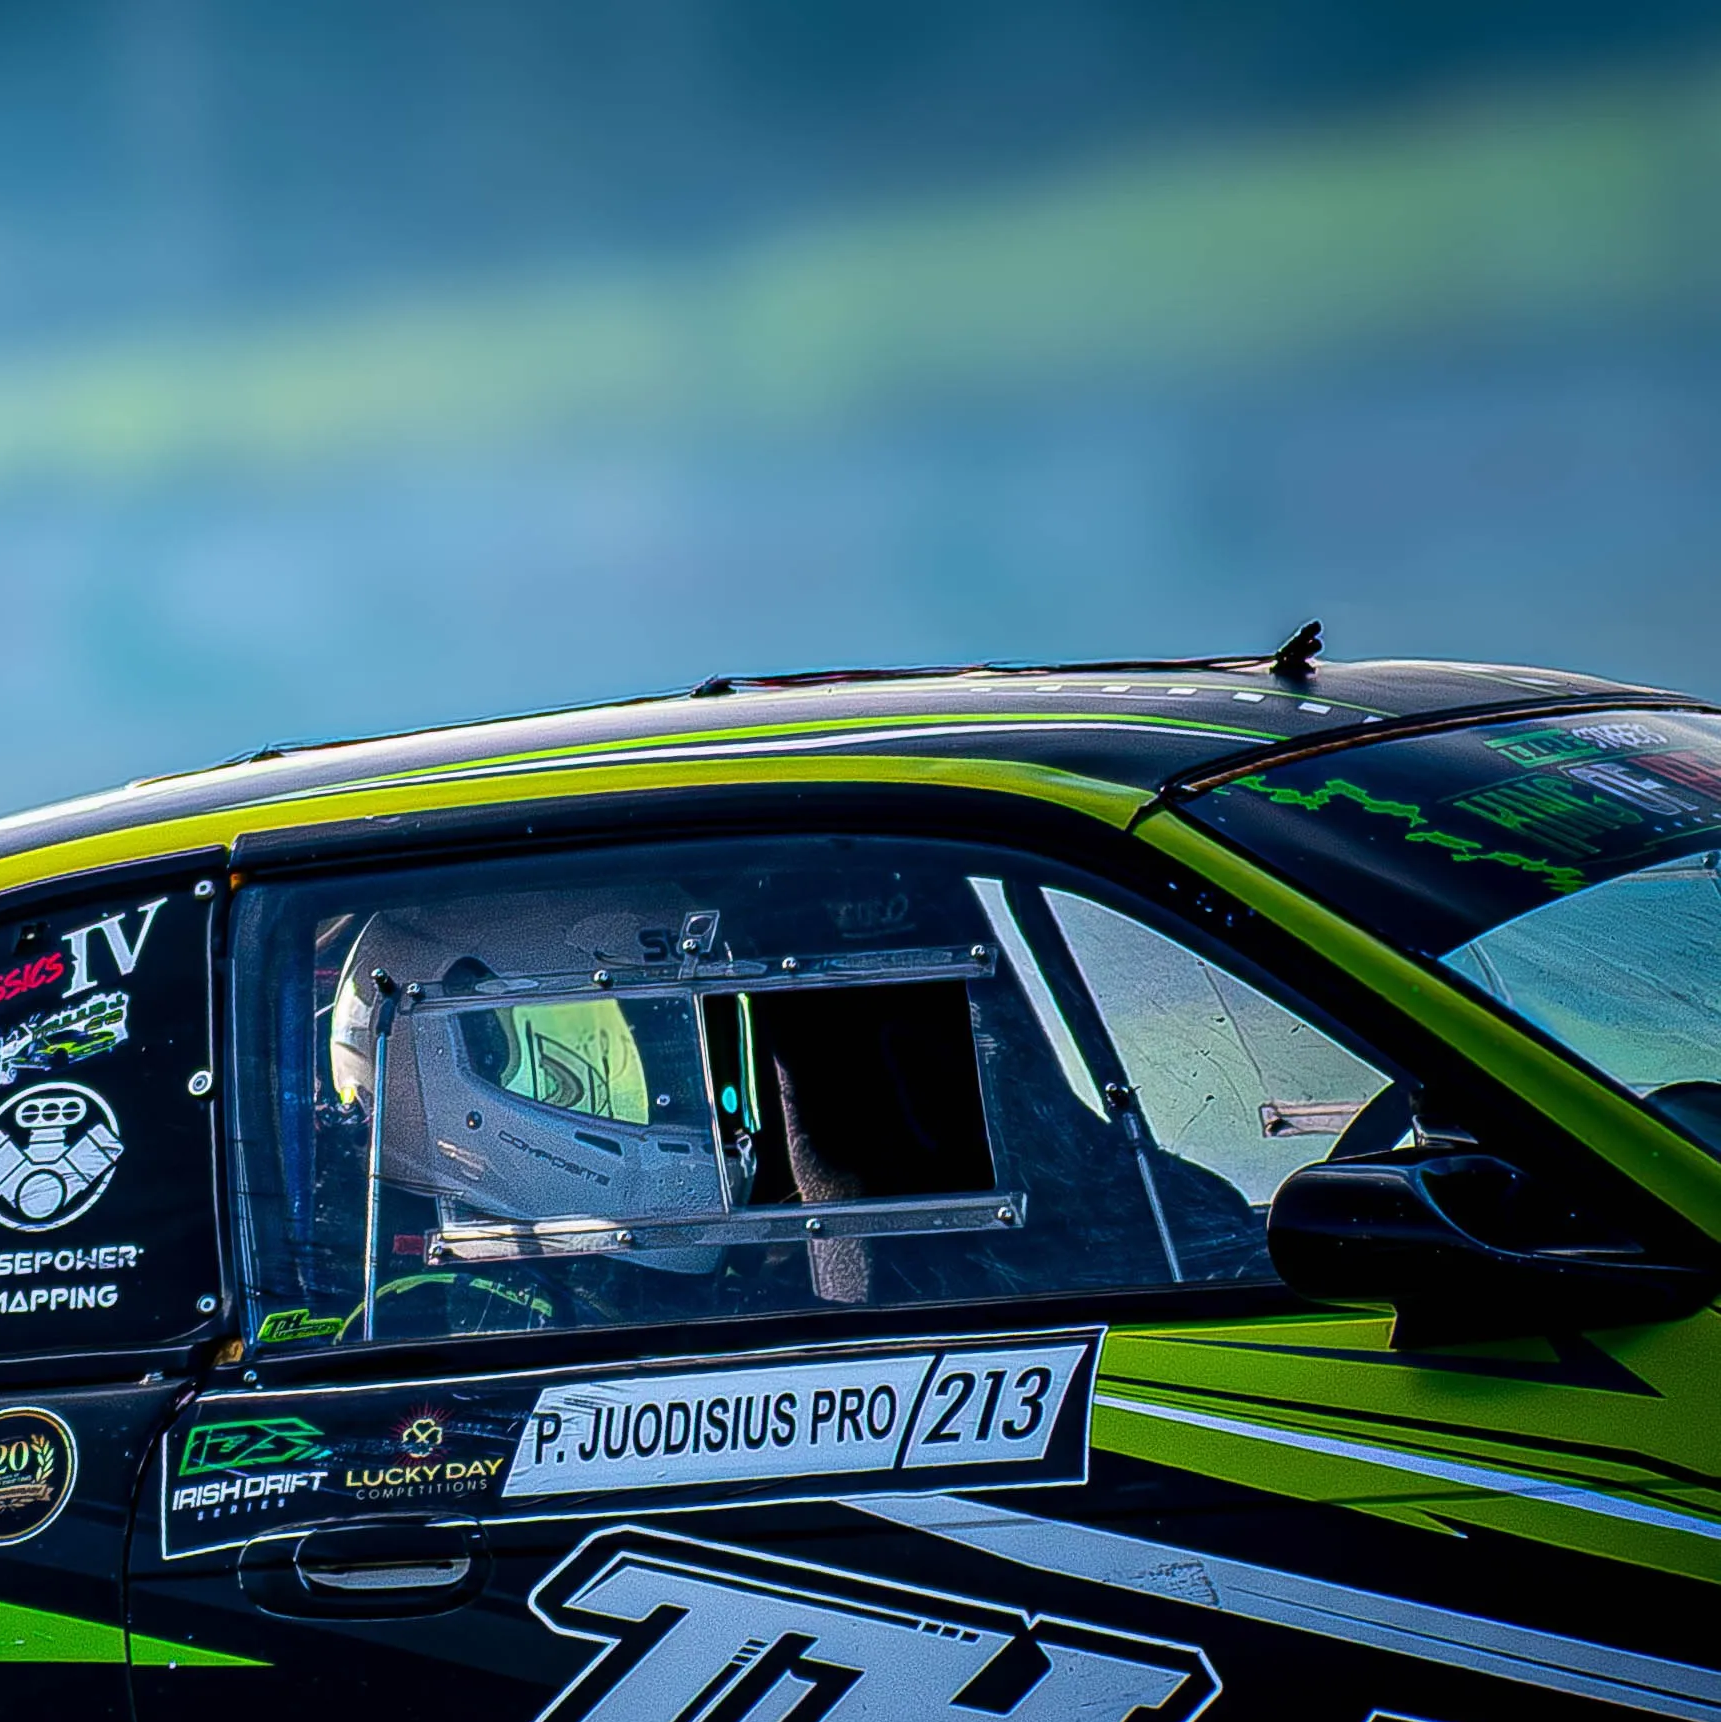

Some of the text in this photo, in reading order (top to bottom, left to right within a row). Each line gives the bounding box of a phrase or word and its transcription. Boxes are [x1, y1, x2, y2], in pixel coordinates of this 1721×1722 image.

[61, 897, 168, 999] IV
[533, 1366, 1053, 1465] P. JUODISIUS PRO 213
[346, 1457, 505, 1487] LUCKY DAY
[356, 1478, 488, 1500] COMPETITIONS
[172, 1471, 328, 1511] IRISH DRIFT
[197, 1498, 286, 1521] SERIES
